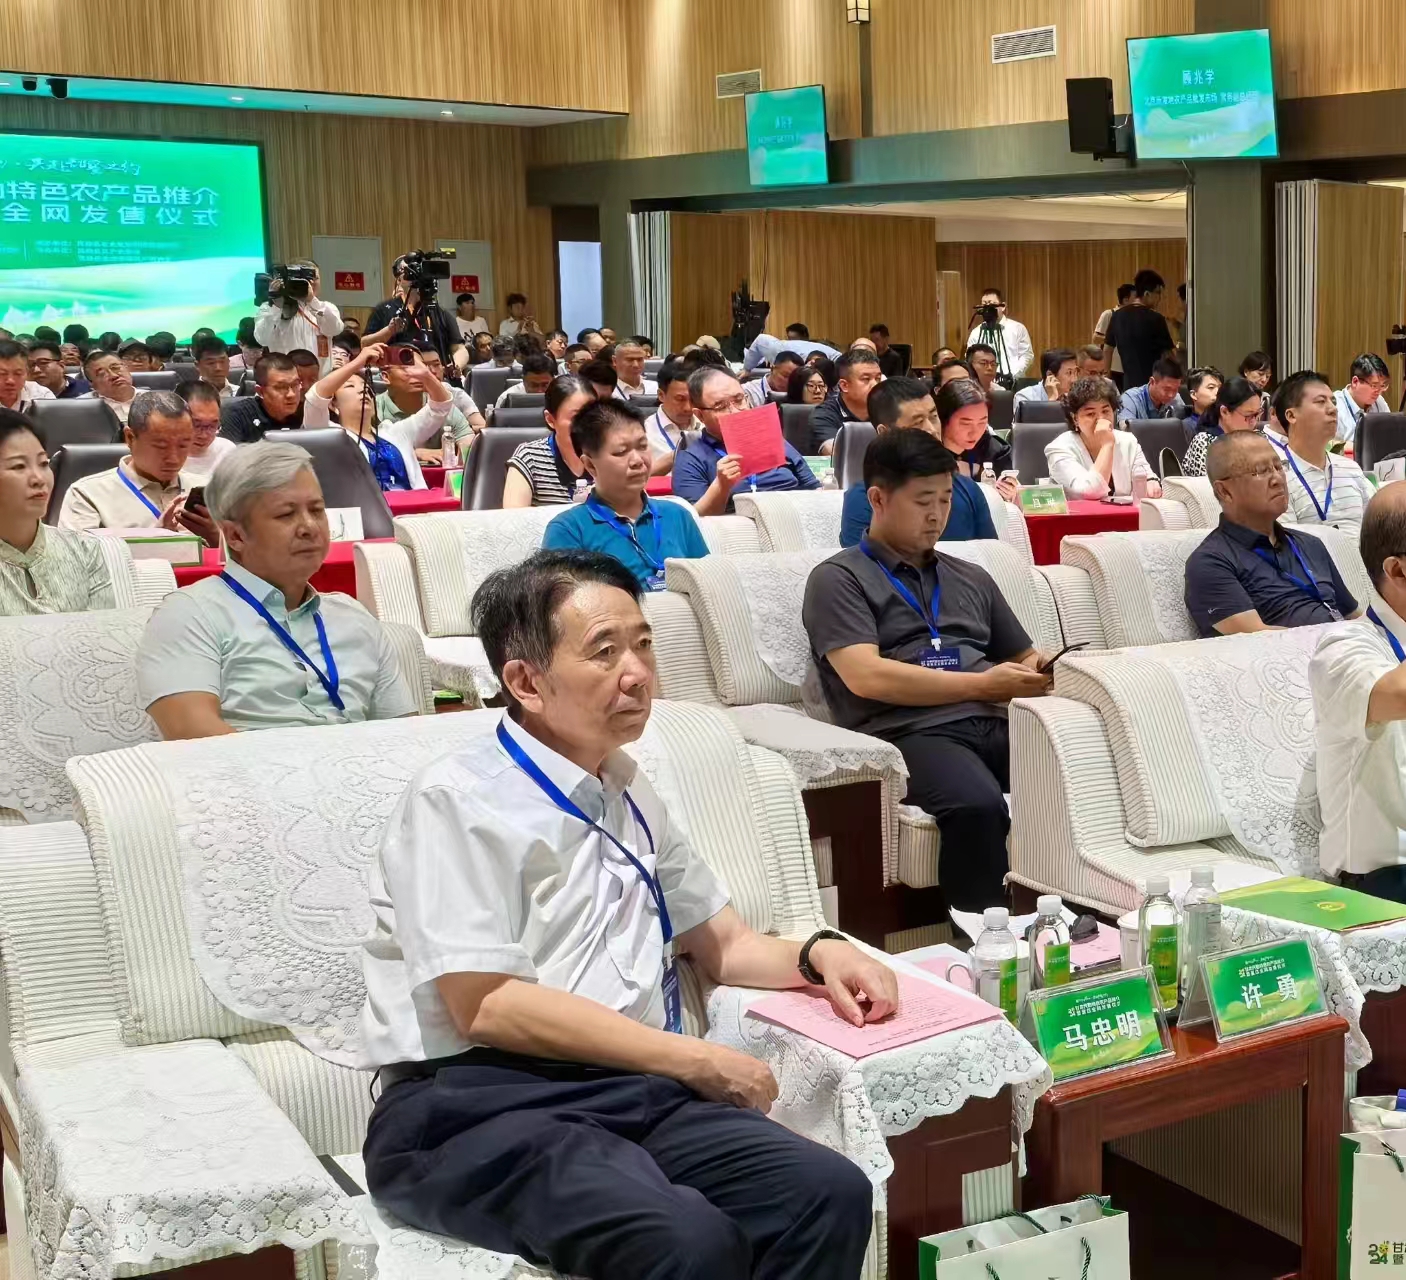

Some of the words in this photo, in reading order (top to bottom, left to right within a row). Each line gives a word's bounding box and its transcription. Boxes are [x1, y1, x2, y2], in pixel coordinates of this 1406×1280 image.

[0, 180, 219, 205] 特色农产品推介
[2, 202, 219, 226] 全网发售仪式
[1241, 972, 1299, 1010] 许勇
[1062, 1009, 1142, 1051] 马忠明
